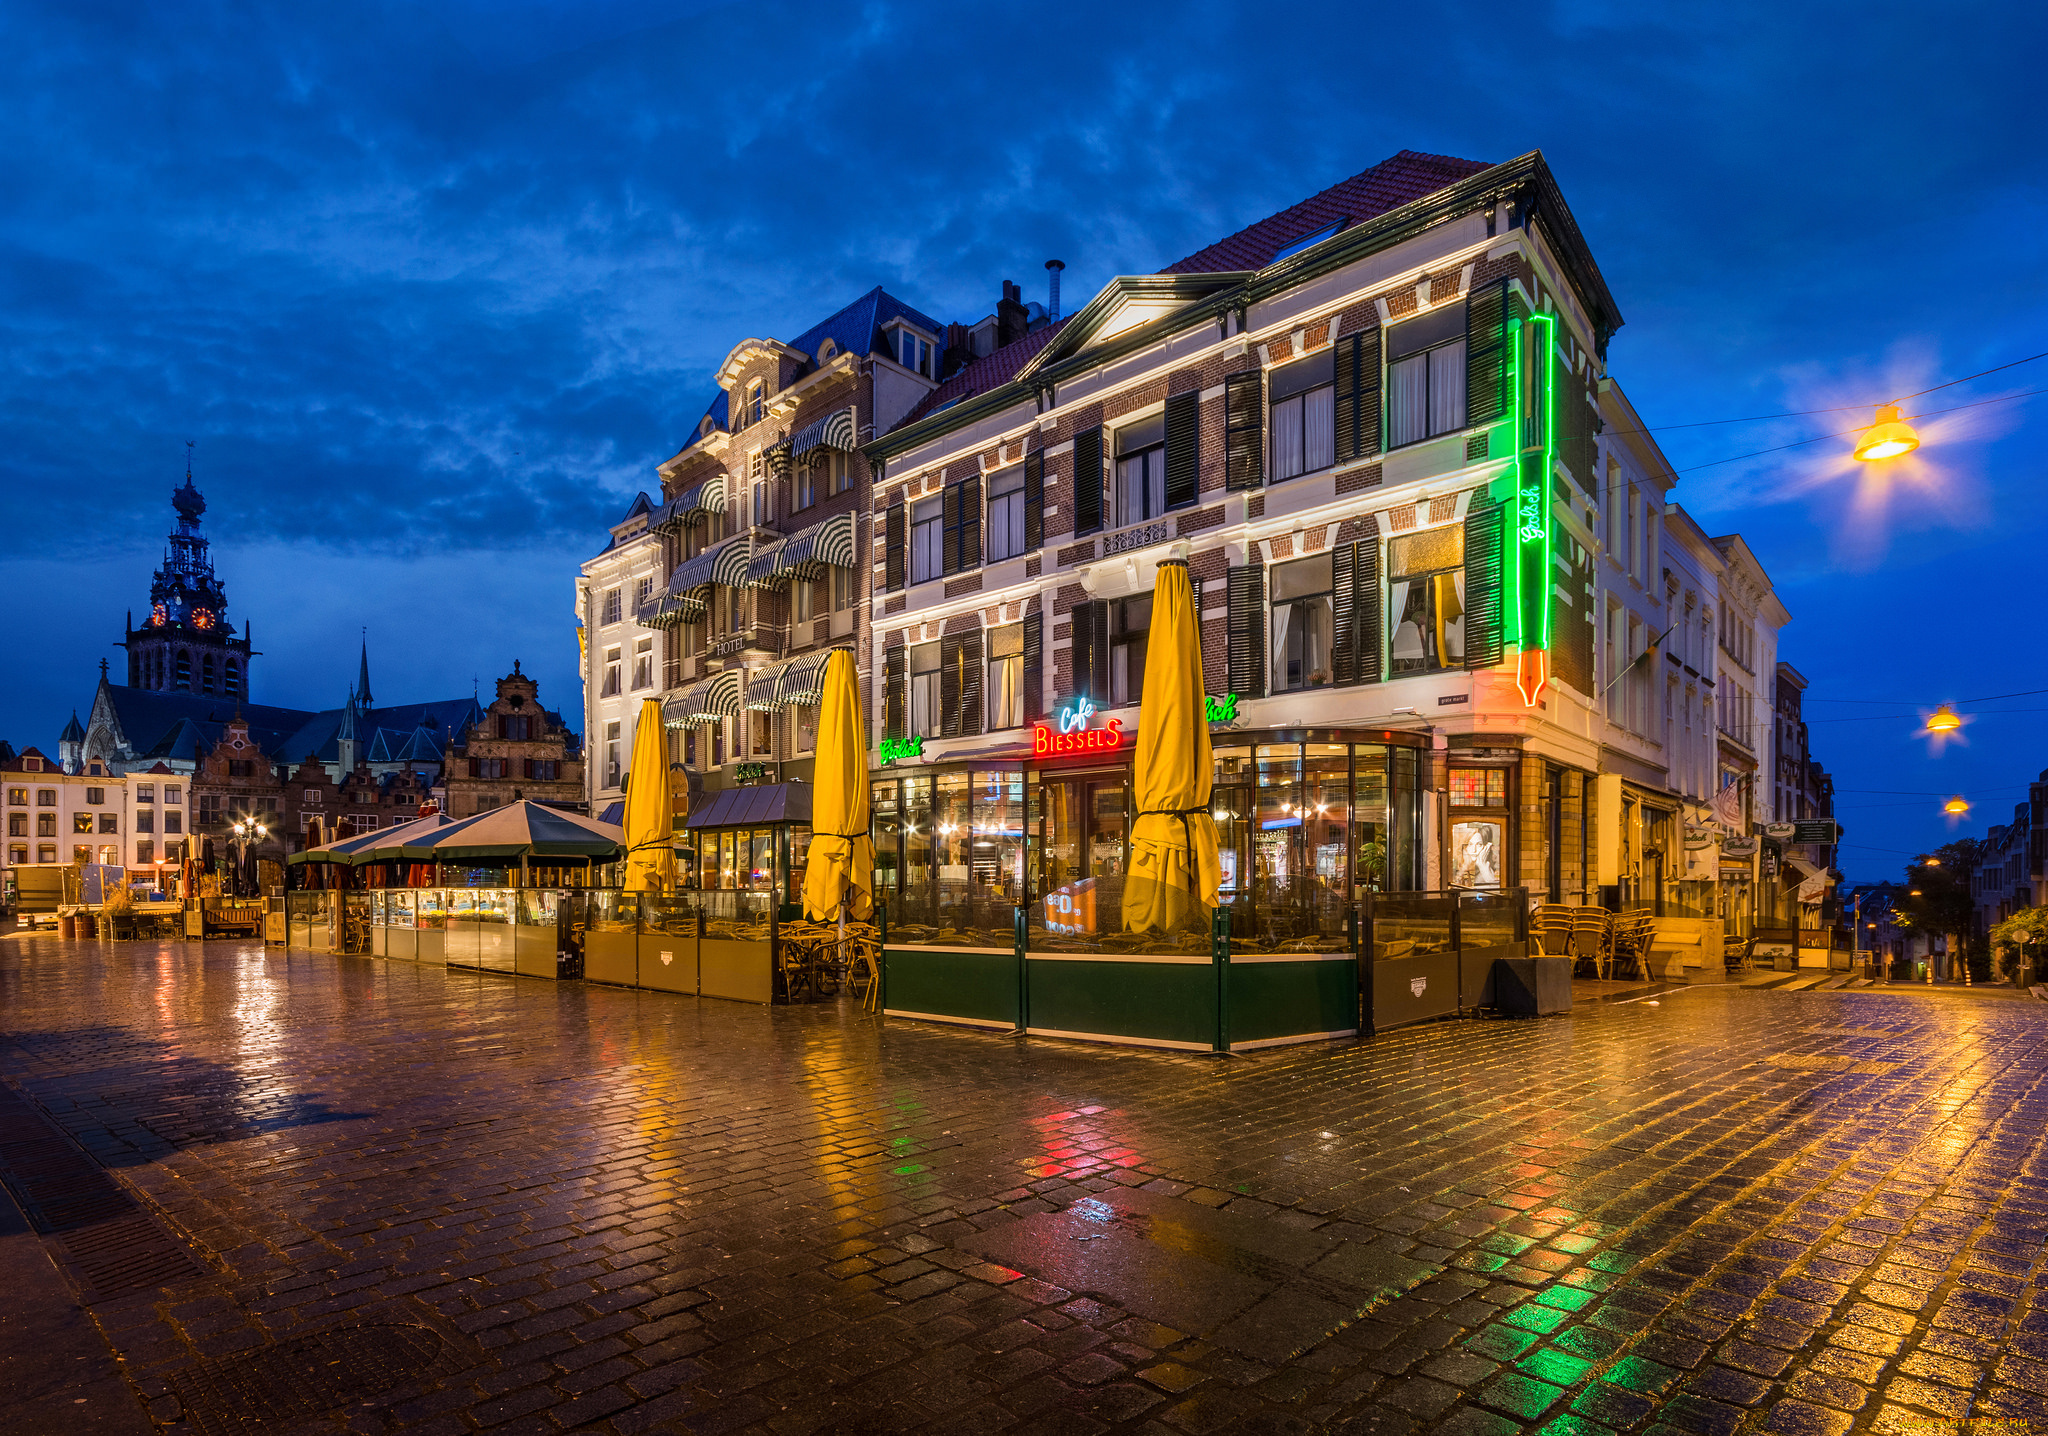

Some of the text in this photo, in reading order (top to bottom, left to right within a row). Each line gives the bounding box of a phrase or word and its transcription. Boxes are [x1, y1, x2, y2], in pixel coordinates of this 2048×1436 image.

[1519, 485, 1545, 543] Grolsch
[717, 637, 745, 656] HOTEL
[1060, 697, 1095, 733] Cafe
[1205, 694, 1237, 722] lsch
[1036, 717, 1120, 753] BIESSELS
[879, 736, 922, 765] Grolsch
[1684, 832, 1708, 842] rolsch
[1768, 825, 1791, 834] Grolsch
[1726, 840, 1754, 850] Grolsch
